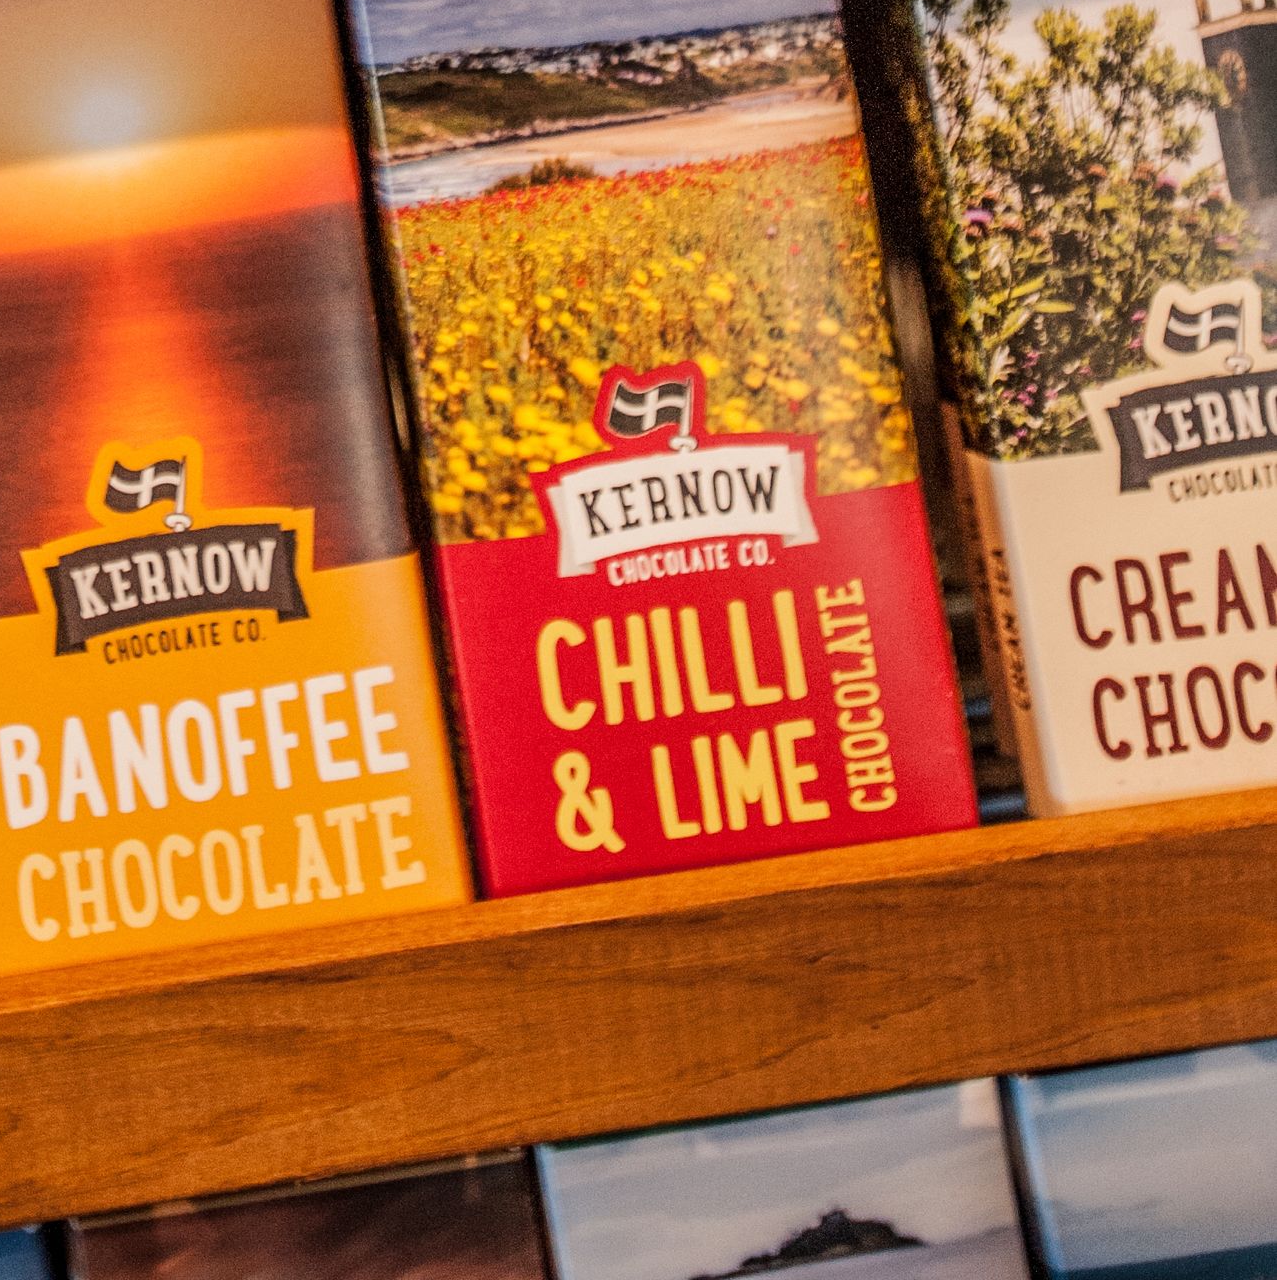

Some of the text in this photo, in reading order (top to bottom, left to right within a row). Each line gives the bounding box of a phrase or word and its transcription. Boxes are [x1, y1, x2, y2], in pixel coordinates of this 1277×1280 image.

[578, 466, 781, 539] KERNOW
[1168, 460, 1277, 504] CHOCOLAT
[69, 540, 277, 620] KERNOW
[607, 539, 775, 587] CHOCOLATE CO.
[103, 618, 266, 665] CHOCOLATE CO.
[536, 588, 809, 731] CHILLI
[816, 578, 899, 814] CHOCOLATE
[1091, 661, 1277, 762] CHOC
[553, 718, 831, 854] & LIME
[17, 796, 427, 943] CHOCOLATE
